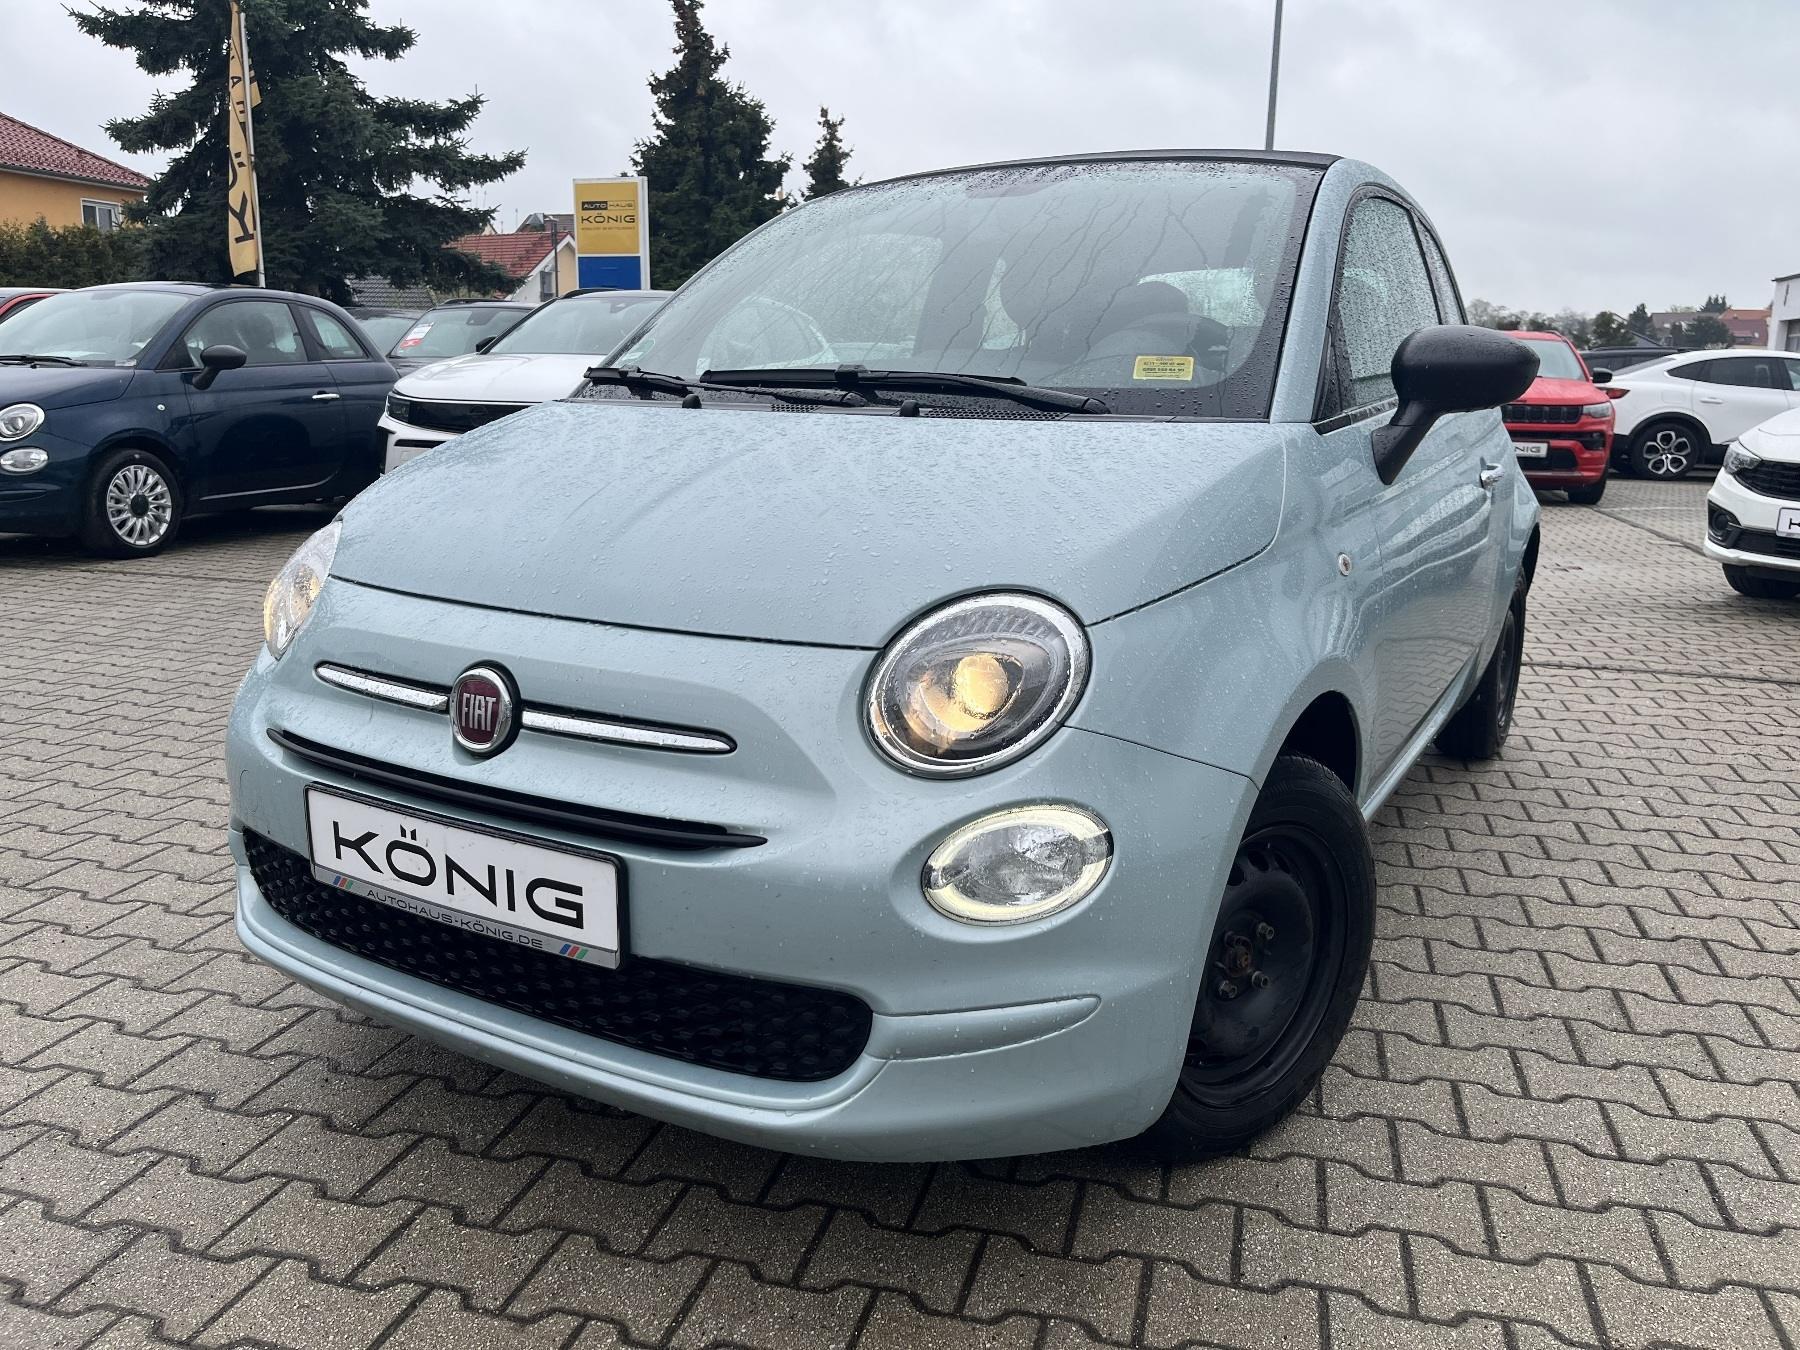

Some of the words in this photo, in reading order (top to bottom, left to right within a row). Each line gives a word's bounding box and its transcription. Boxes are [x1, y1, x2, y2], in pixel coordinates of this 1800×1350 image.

[581, 212, 636, 224] KÖNIG
[1514, 446, 1541, 454] NIG
[461, 692, 497, 731] FIAT
[332, 820, 584, 930] KÖNIG
[366, 888, 544, 950] AUTOHAUS-KÖNIG.DE
